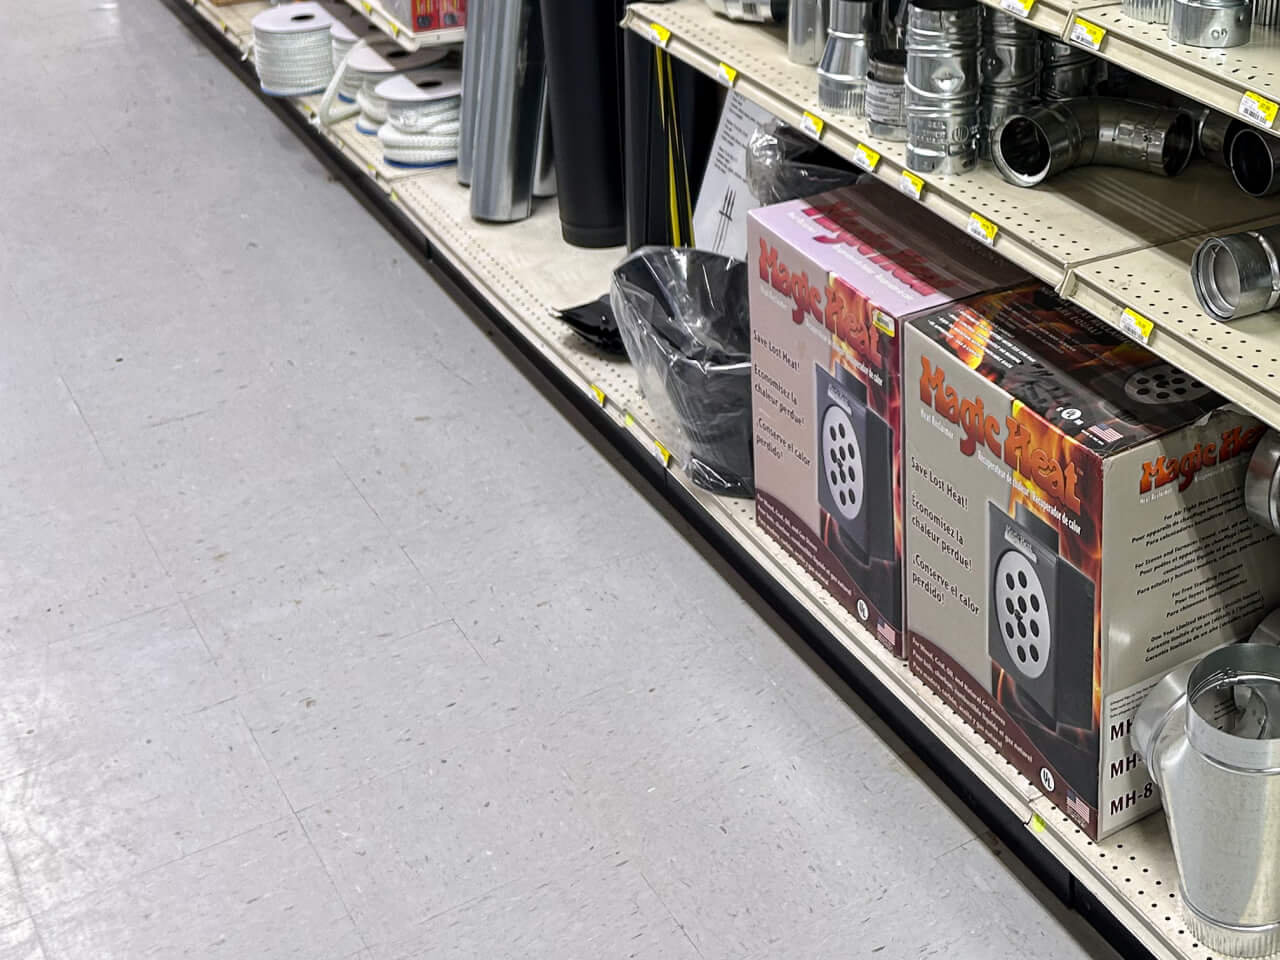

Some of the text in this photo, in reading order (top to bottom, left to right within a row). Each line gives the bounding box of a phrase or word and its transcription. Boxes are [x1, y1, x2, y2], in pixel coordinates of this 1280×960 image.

[759, 236, 823, 325] Magic
[825, 286, 882, 369] Heat
[753, 329, 801, 371] Save Lost Heat!
[754, 383, 779, 409] chaleur
[920, 354, 1081, 517] Magic Heat
[794, 445, 811, 467] calor
[1139, 425, 1267, 495] Magic He
[911, 456, 969, 510] Save Lost Heat!
[911, 516, 972, 572] chaleur perdue!
[956, 527, 965, 546] la
[1131, 533, 1145, 543] Pour
[1146, 523, 1171, 537] appareils
[1146, 537, 1158, 546] Para
[912, 572, 946, 606] perdido!
[950, 584, 959, 599] el
[959, 588, 980, 616] calor
[1174, 596, 1187, 604] Pour
[1181, 585, 1192, 593] Free
[1166, 609, 1178, 617] Para
[1150, 633, 1162, 641] One
[1163, 627, 1175, 635] Year
[1176, 618, 1195, 630] Limited
[1110, 782, 1153, 817] MH-8
